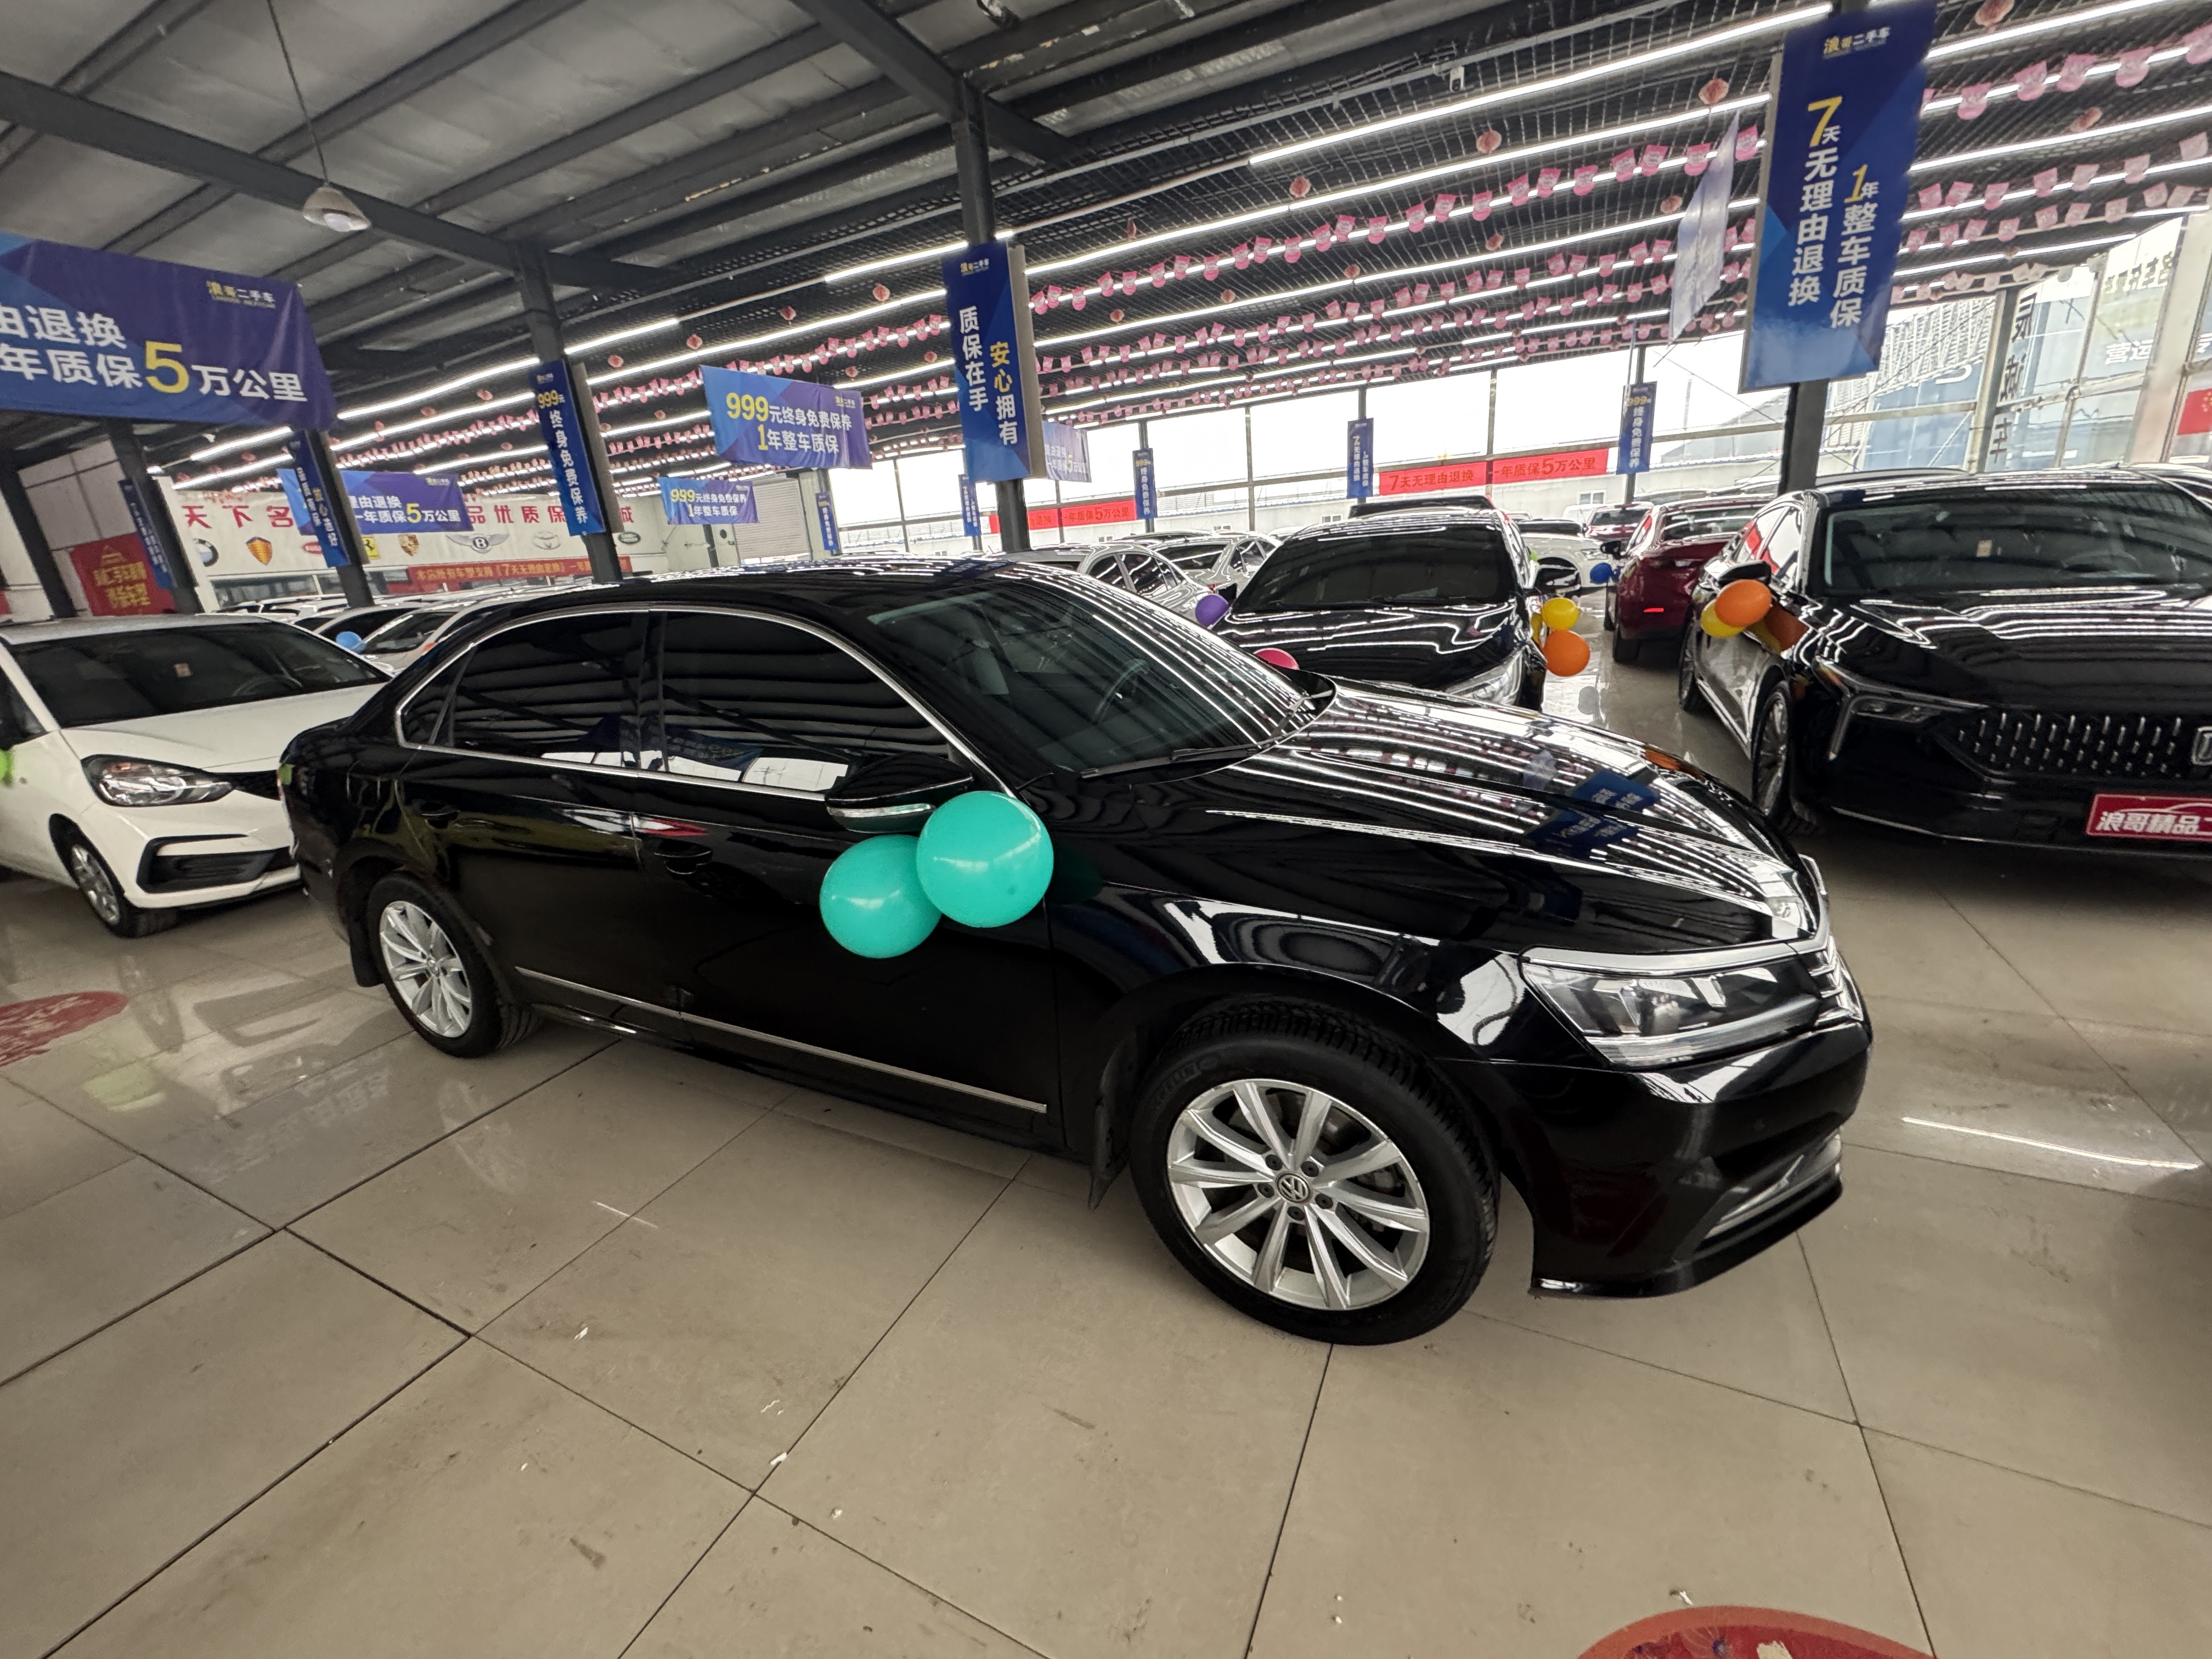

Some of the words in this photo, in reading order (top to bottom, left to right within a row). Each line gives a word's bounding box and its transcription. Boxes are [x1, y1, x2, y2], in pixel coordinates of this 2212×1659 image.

[1788, 95, 1843, 307] 7天无理由退换
[1830, 164, 1879, 329] 1年整车质保
[960, 306, 989, 411] 质保在手
[726, 392, 852, 431] 999元终身免费保养
[990, 341, 1018, 445] 安心拥有
[758, 424, 839, 454] 1年整车质保
[549, 410, 588, 524] 终身免费保养
[1389, 469, 1475, 491] 7天无理由退换
[1493, 456, 1596, 476] 一年质保5万公里
[182, 505, 294, 529] 天下名
[2096, 811, 2212, 835] 浪哥精品
